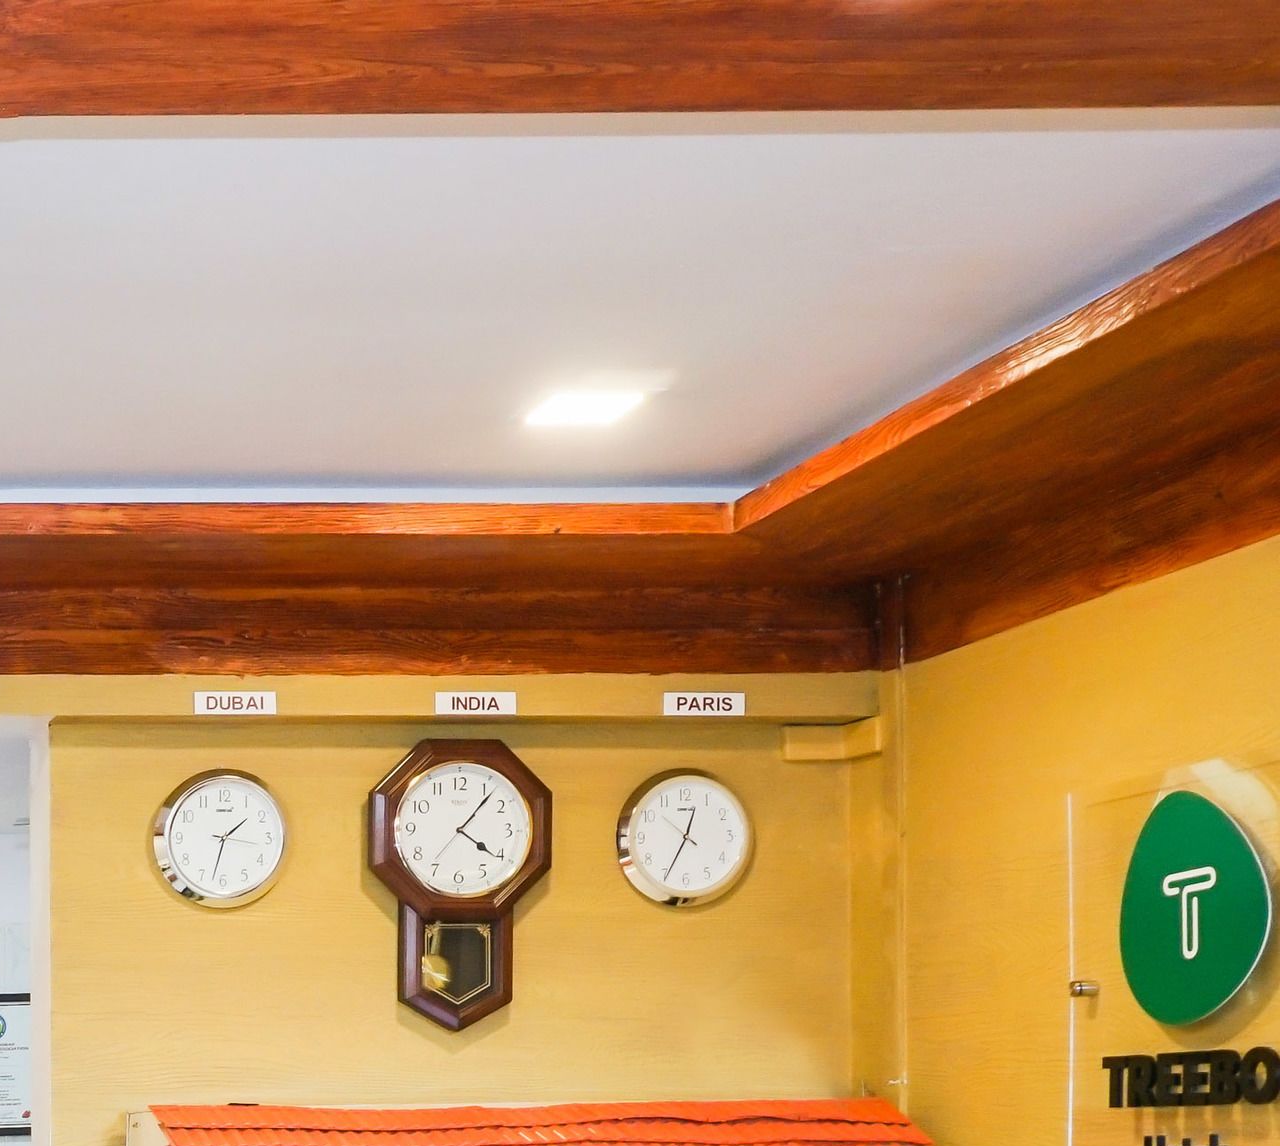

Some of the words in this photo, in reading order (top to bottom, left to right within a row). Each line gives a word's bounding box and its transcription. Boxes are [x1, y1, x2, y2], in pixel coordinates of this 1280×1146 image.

[206, 695, 264, 710] DUBAI
[451, 696, 500, 711] INDIA
[676, 696, 733, 711] PARIS
[433, 782, 442, 796] 11
[453, 776, 467, 791] 12
[482, 783, 486, 796] 1
[219, 789, 231, 802] 12
[660, 794, 669, 808] 11
[679, 788, 691, 801] 12
[705, 793, 709, 806] 1
[199, 795, 208, 808] 11
[244, 795, 248, 808] 1
[413, 800, 430, 814] 10
[496, 800, 505, 814] 2
[182, 810, 194, 823] 10
[258, 810, 266, 823] 2
[643, 809, 656, 823] 10
[718, 808, 727, 821] 2
[405, 822, 416, 836] 9
[505, 823, 513, 838] 3
[175, 832, 183, 844] 9
[265, 832, 273, 845] 3
[637, 832, 645, 844] 9
[727, 830, 734, 842] 3
[181, 853, 190, 866] 8
[256, 853, 264, 866] 4
[413, 847, 423, 860] 8
[495, 848, 504, 861] 4
[644, 853, 652, 865] 8
[718, 851, 725, 864] 4
[198, 869, 205, 881] 7
[241, 869, 248, 882] 5
[431, 863, 440, 877] 7
[479, 864, 487, 879] 5
[661, 868, 668, 881] 7
[703, 867, 711, 880] 5
[219, 874, 227, 887] 6
[453, 871, 464, 884] 6
[682, 873, 690, 886] 6
[1163, 866, 1216, 960] T
